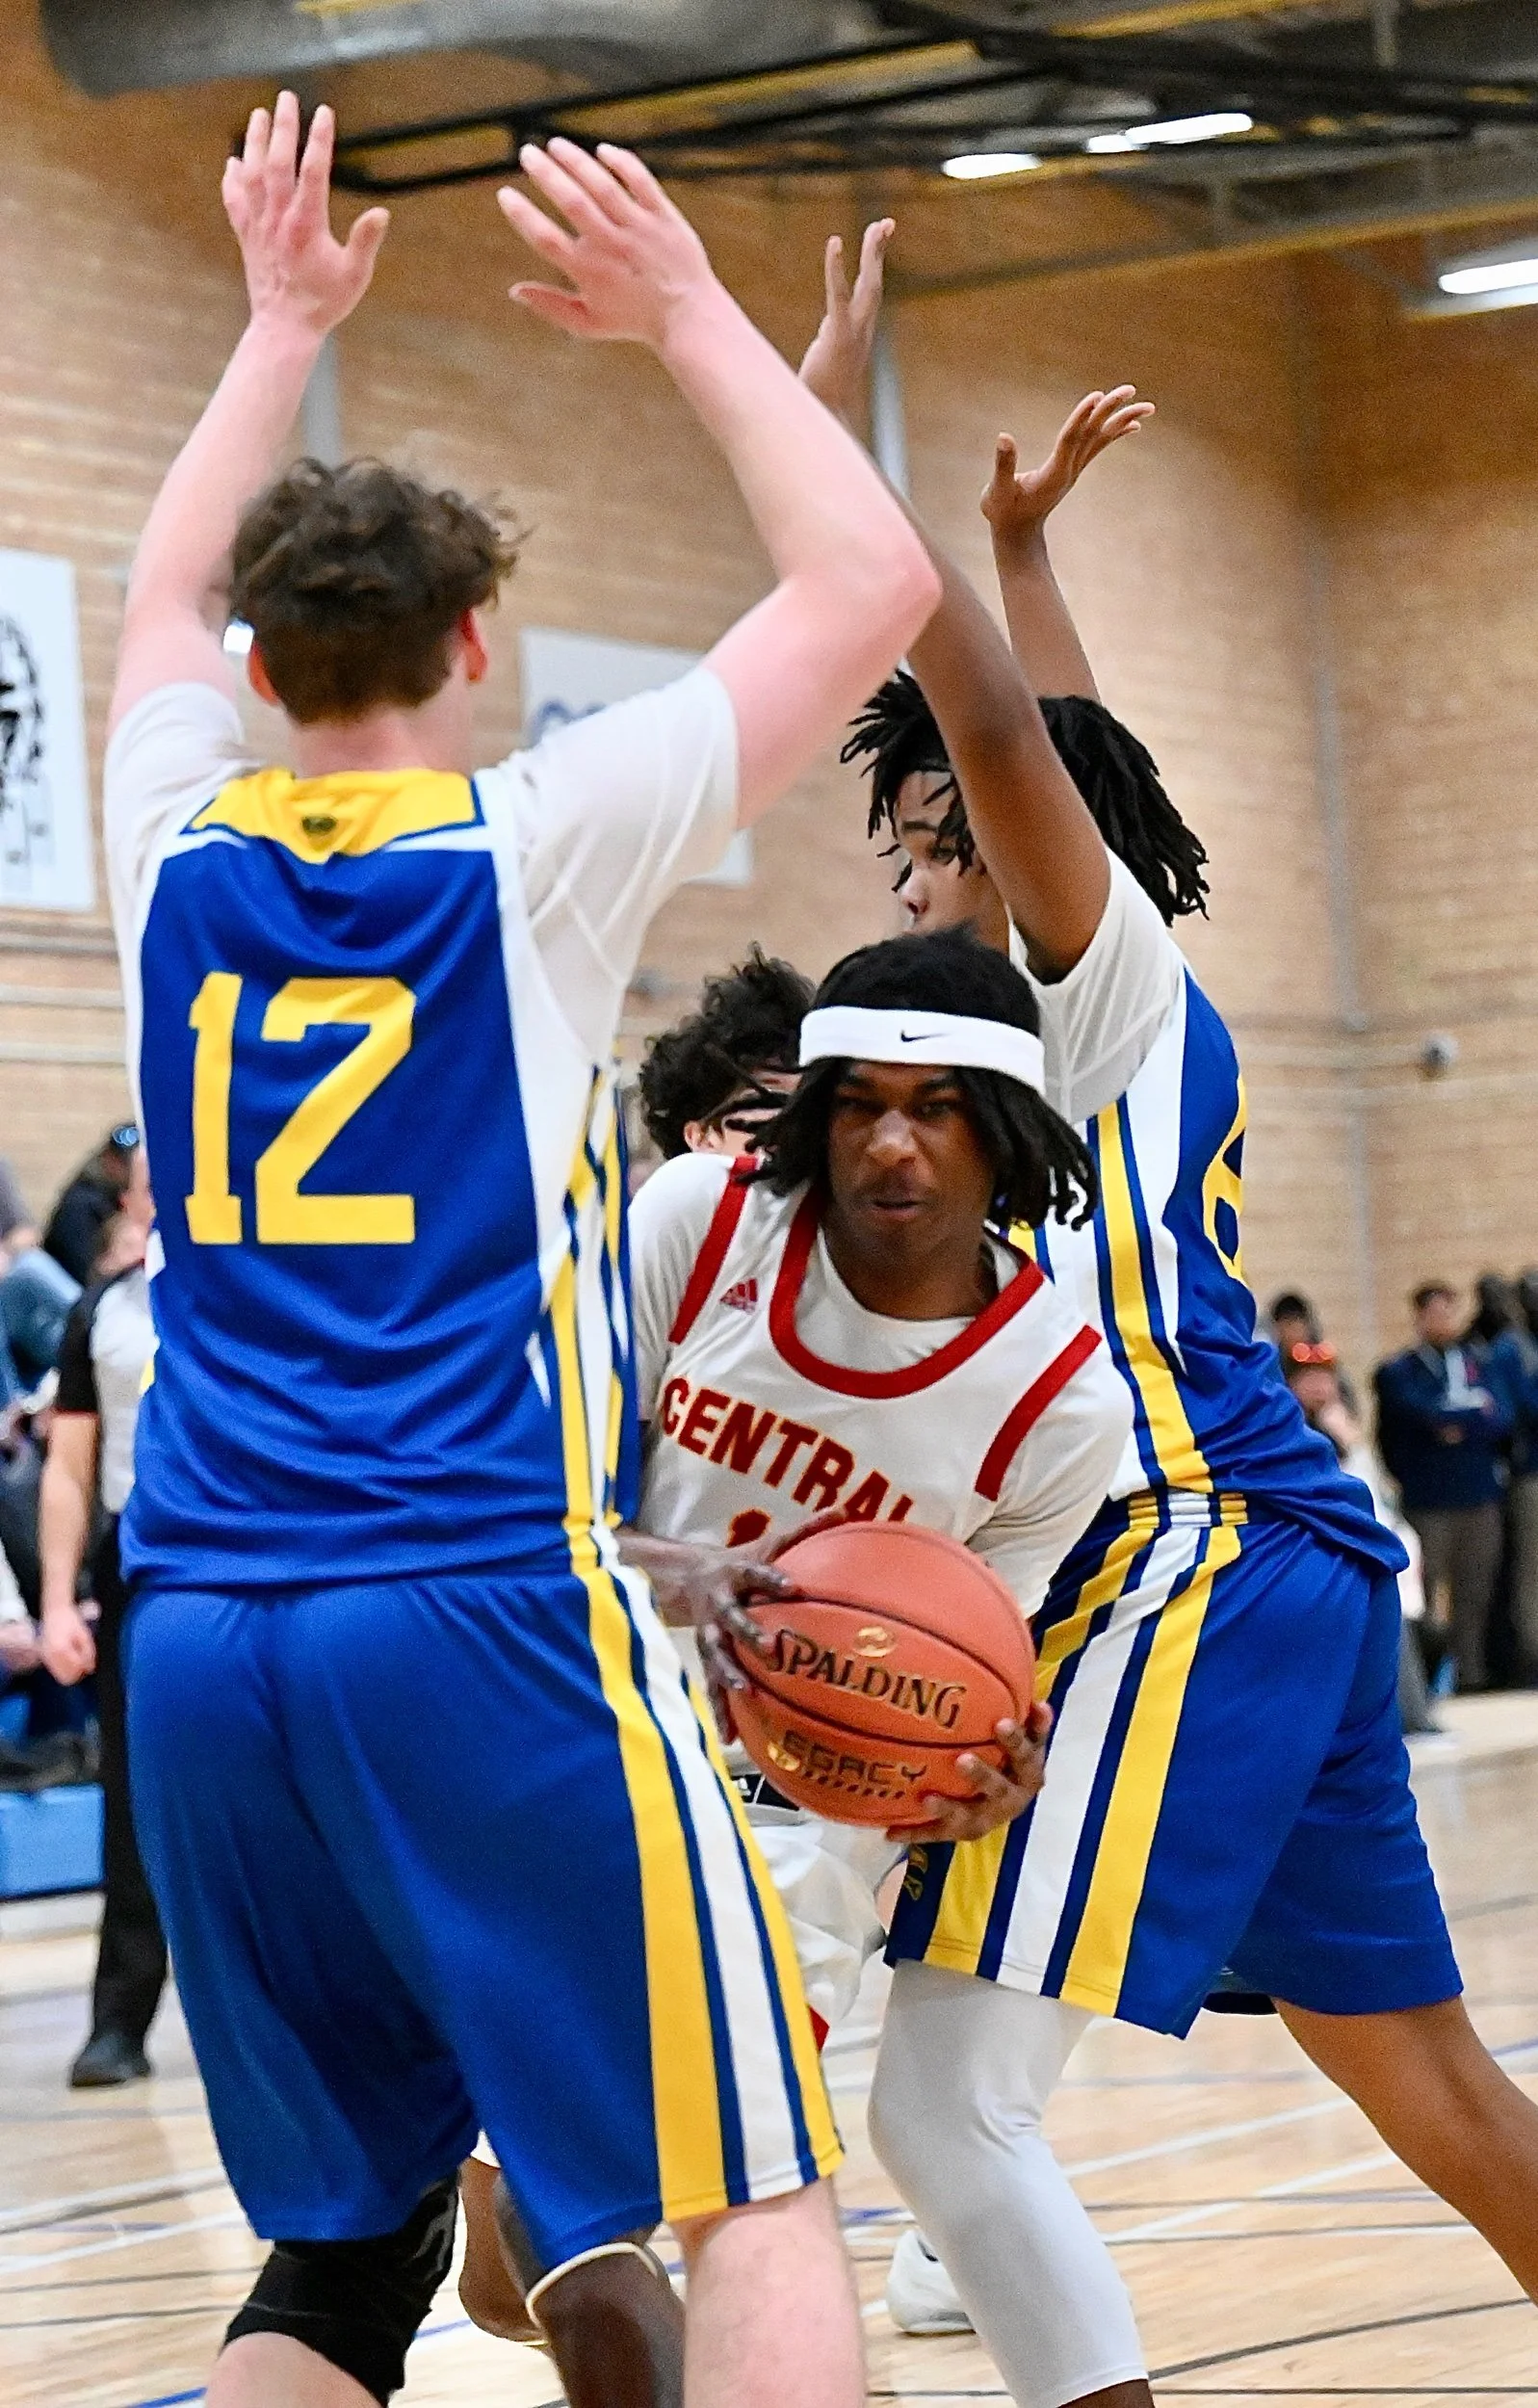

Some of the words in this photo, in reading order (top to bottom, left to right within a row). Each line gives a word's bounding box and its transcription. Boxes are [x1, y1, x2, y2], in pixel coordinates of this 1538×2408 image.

[185, 971, 416, 1244] 12
[768, 1628, 967, 1729] SPALDING
[762, 1718, 927, 1785] EGACY
